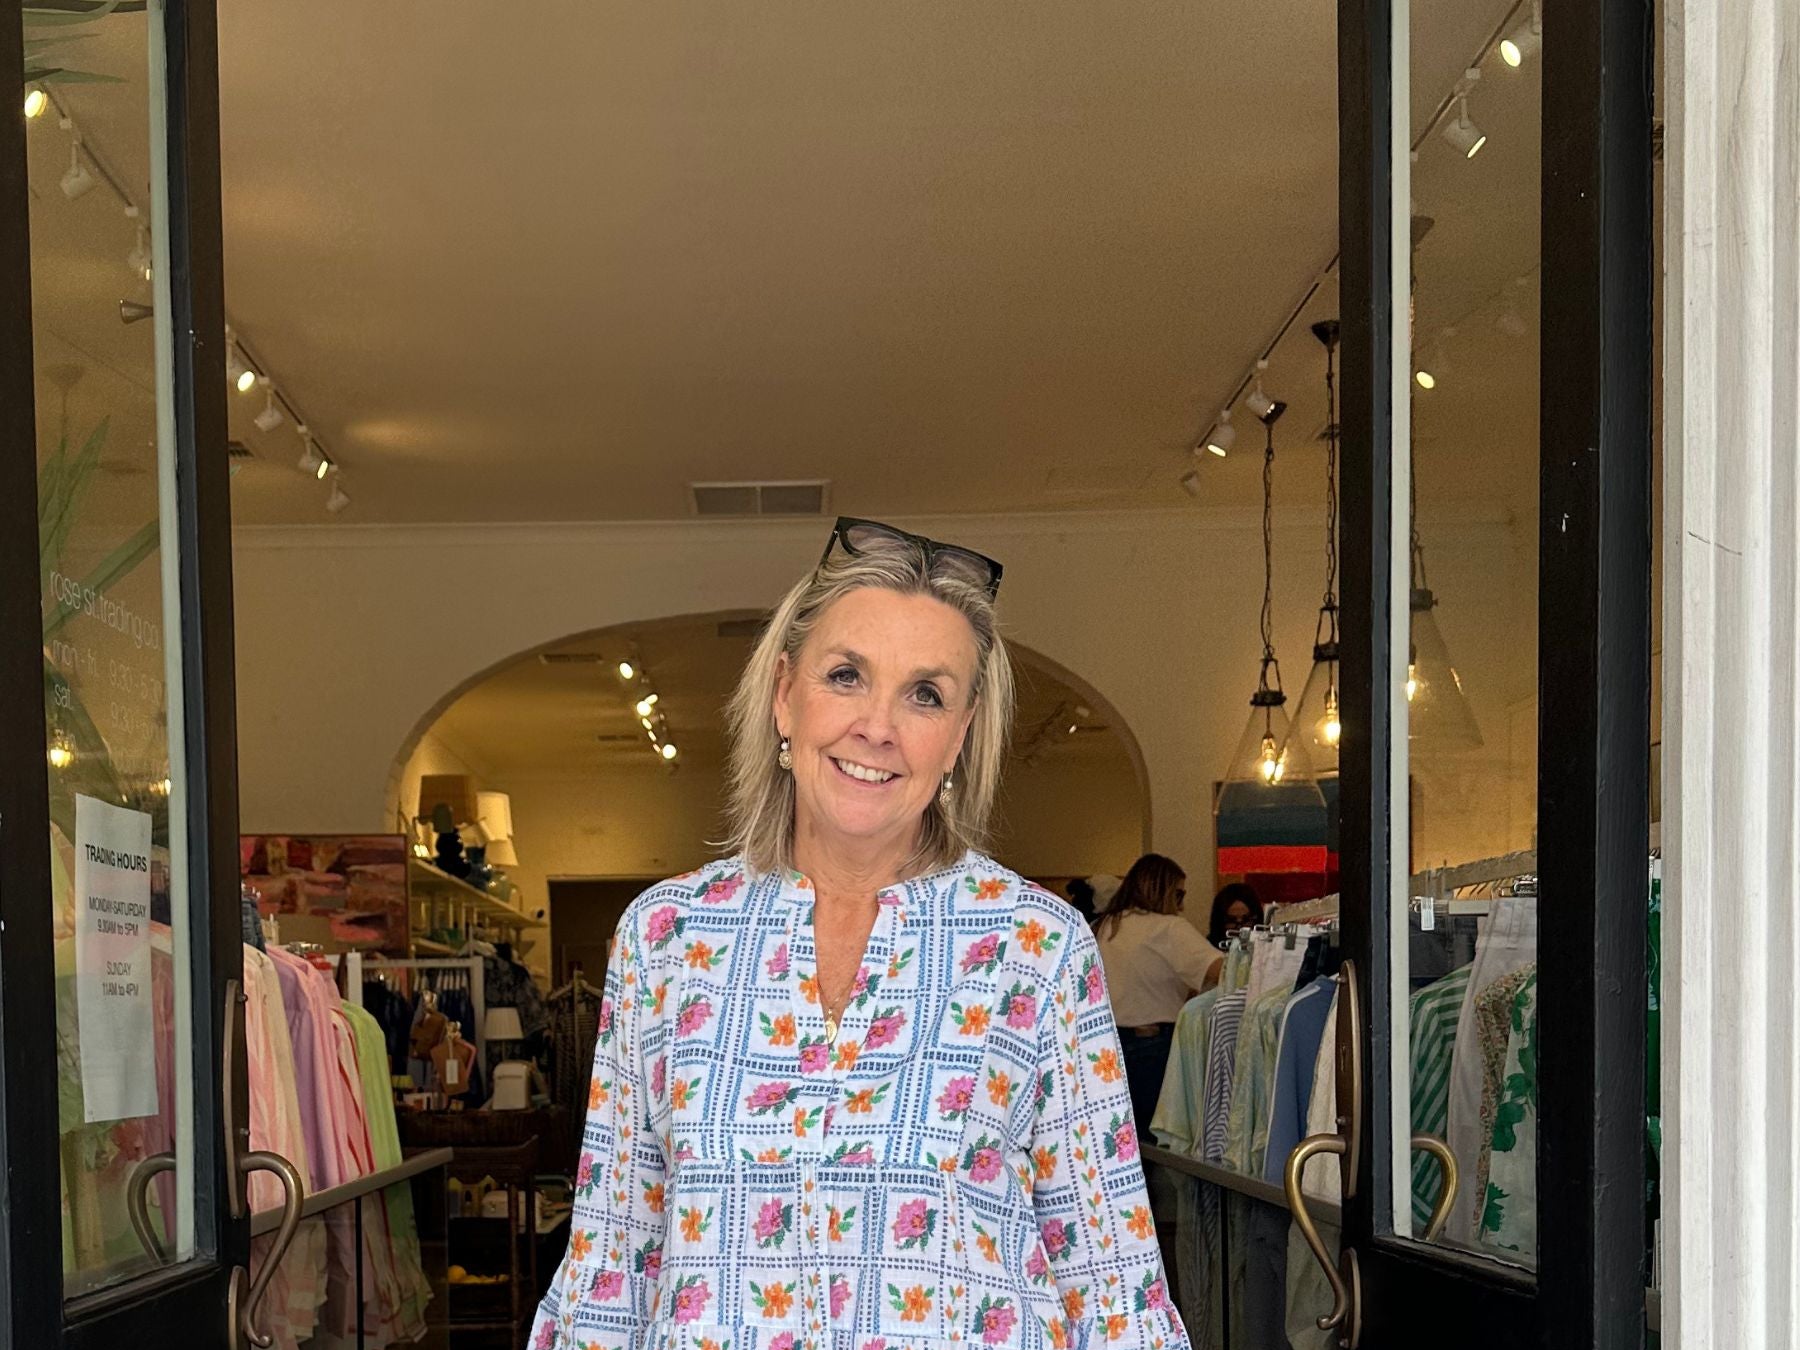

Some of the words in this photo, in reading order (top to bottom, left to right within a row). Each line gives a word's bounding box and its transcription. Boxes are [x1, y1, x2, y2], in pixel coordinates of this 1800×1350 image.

[50, 570, 81, 610] rose
[52, 639, 78, 670] mon
[85, 844, 115, 867] TRADING
[117, 852, 147, 873] HOURS
[117, 923, 123, 936] to
[125, 923, 138, 937] 5PM
[106, 960, 131, 976] SUNDAY
[118, 985, 125, 997] to
[126, 982, 139, 997] 4PM
